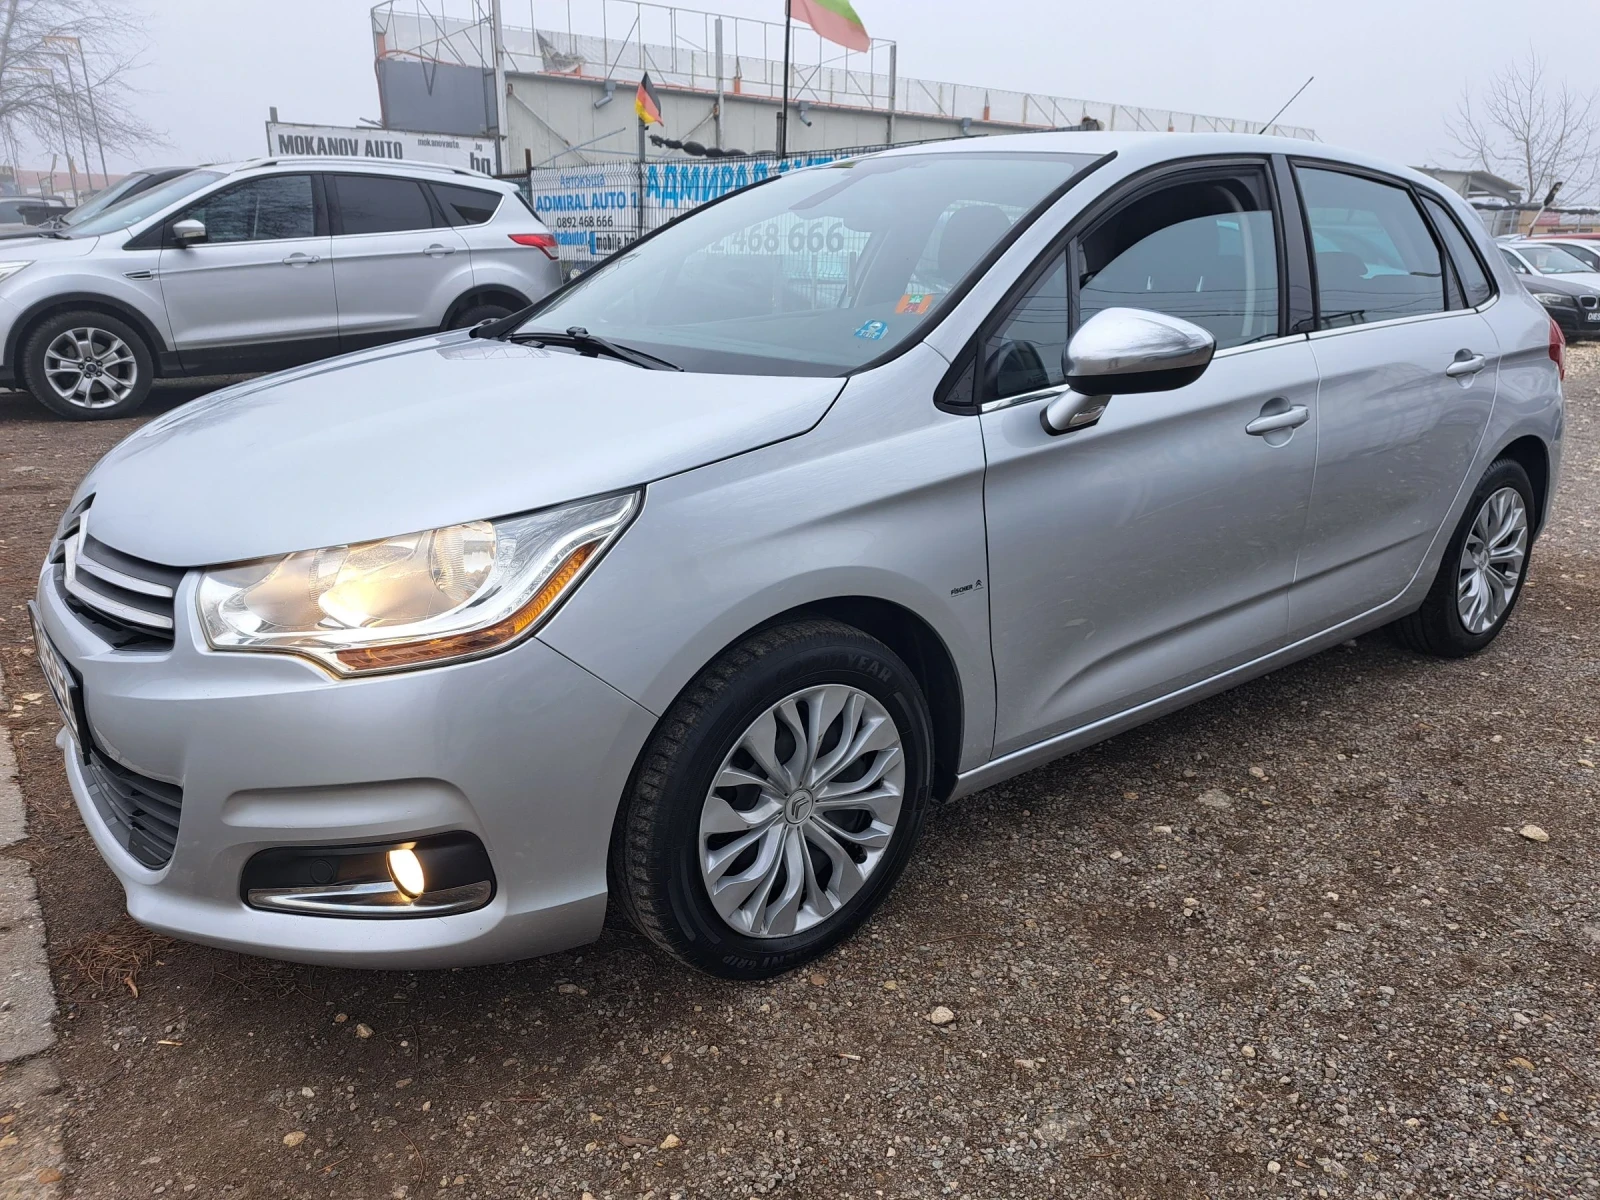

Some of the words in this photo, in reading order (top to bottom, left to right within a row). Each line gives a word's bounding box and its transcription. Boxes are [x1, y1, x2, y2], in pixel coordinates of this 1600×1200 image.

[277, 134, 359, 156] MOKANOV
[364, 139, 403, 159] AUTO
[536, 194, 588, 211] ADMIRAL
[591, 191, 627, 210] AUTO
[630, 191, 637, 209] 1
[556, 216, 577, 228] 0892
[578, 216, 595, 228] 468
[596, 216, 614, 227] 666
[787, 222, 845, 253] 666
